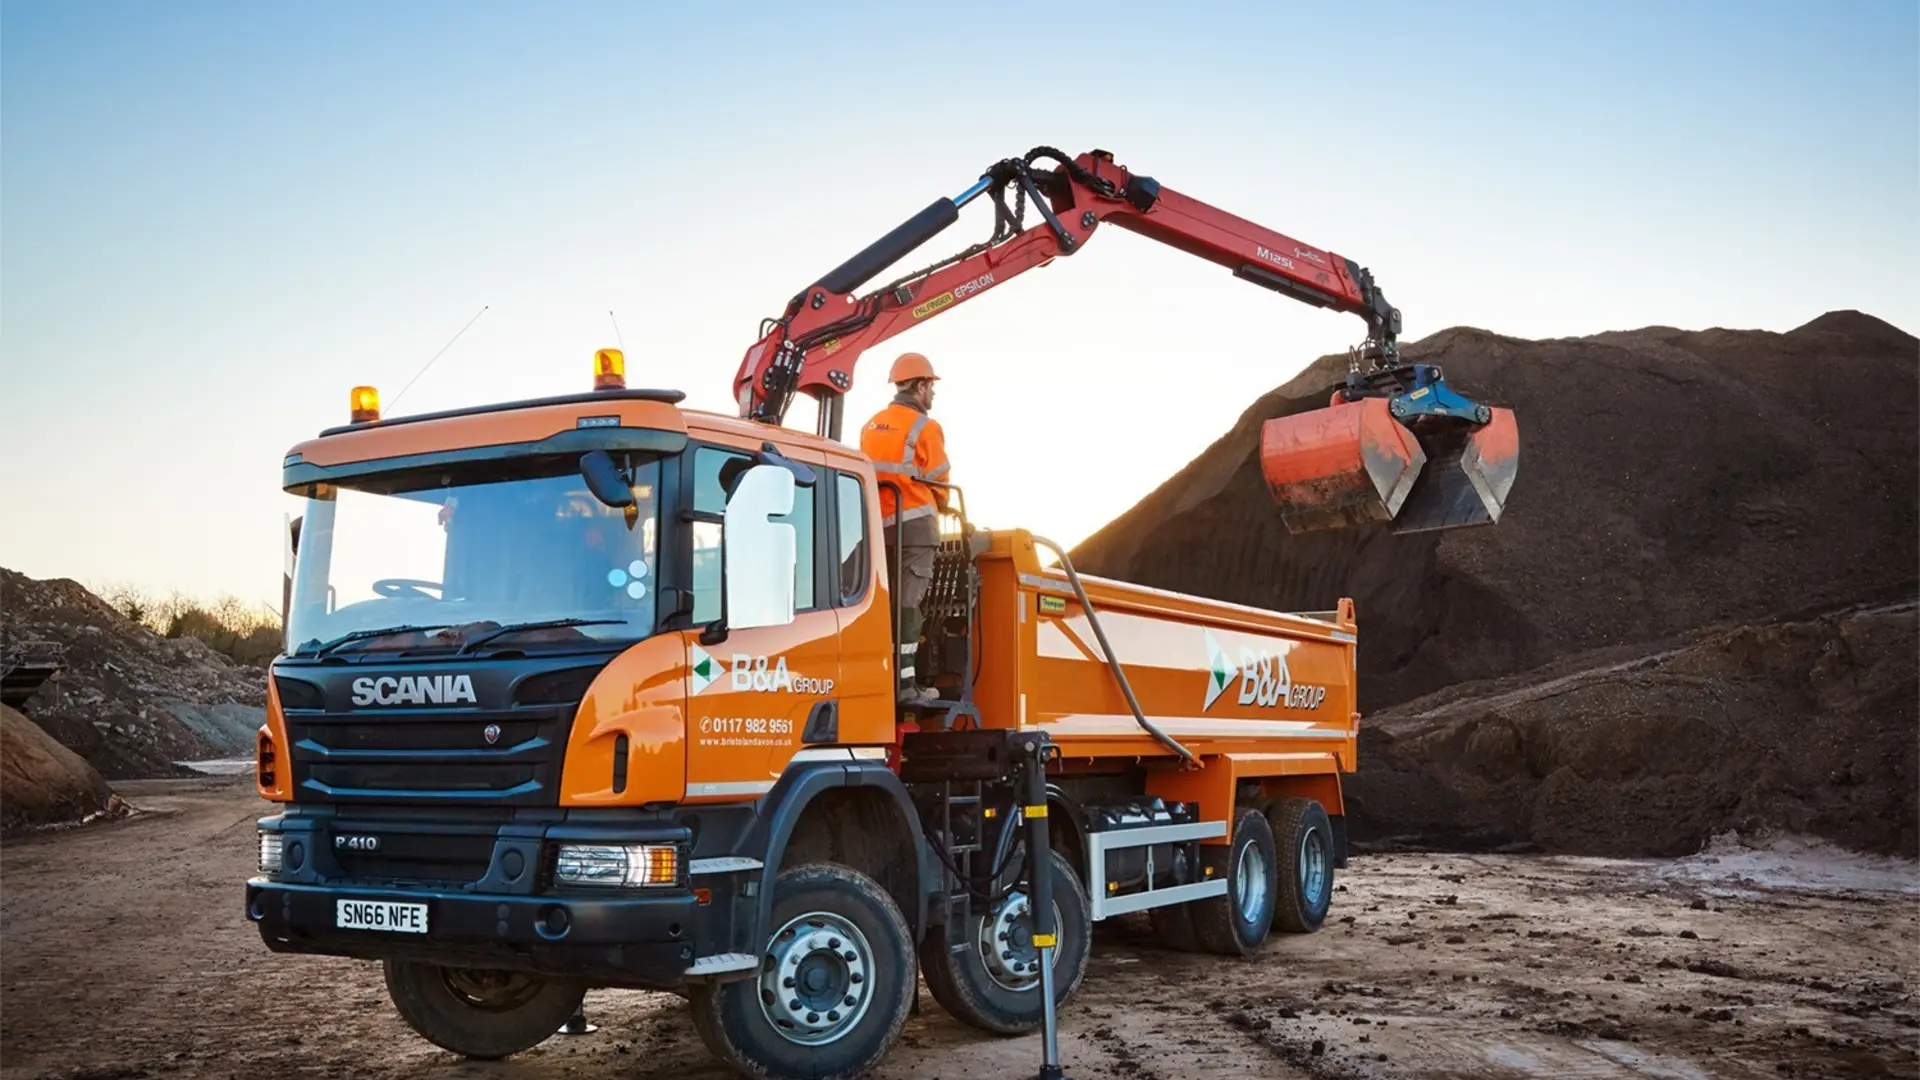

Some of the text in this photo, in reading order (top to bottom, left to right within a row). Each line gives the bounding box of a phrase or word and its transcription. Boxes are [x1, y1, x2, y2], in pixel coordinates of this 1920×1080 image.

[914, 272, 995, 316] PALFINGER EPSILON
[731, 653, 834, 694] B&A GROUP
[1238, 647, 1326, 710] B&A GROUP
[351, 674, 477, 705] SCANIA
[713, 717, 793, 734] 0117 982 9561
[335, 836, 377, 850] P 410
[343, 903, 420, 928] SN66 NFE
